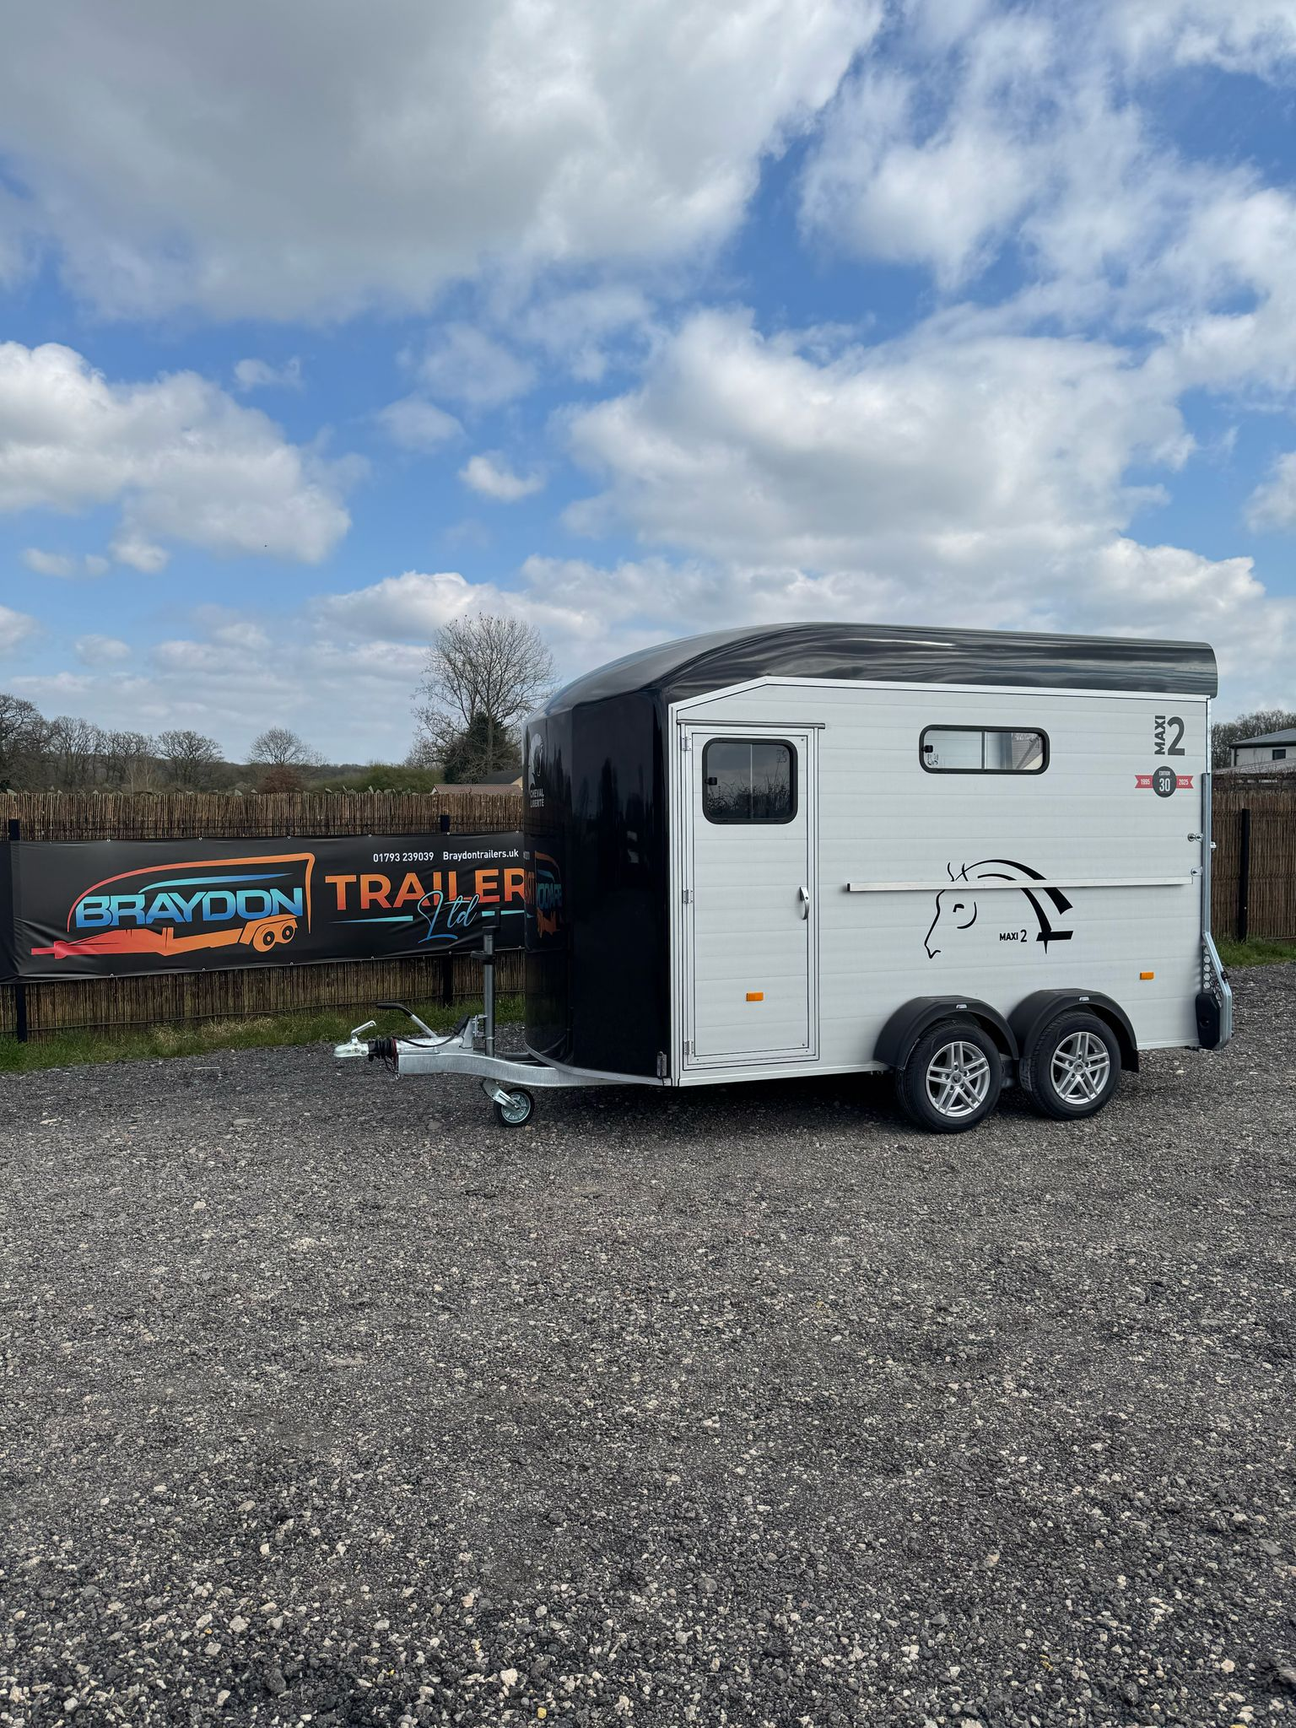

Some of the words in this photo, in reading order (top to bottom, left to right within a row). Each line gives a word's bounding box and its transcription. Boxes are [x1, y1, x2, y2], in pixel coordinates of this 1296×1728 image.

[1154, 715, 1166, 755] MAXI
[1167, 716, 1186, 756] 2
[1159, 777, 1170, 792] 30
[373, 853, 400, 863] 01793
[402, 851, 435, 862] 239039
[443, 848, 519, 862] Braydontrailers.uk
[75, 887, 303, 929] BRAYDON
[417, 890, 480, 944] Ltd
[999, 932, 1019, 941] MAXI
[1020, 929, 1027, 942] 2
